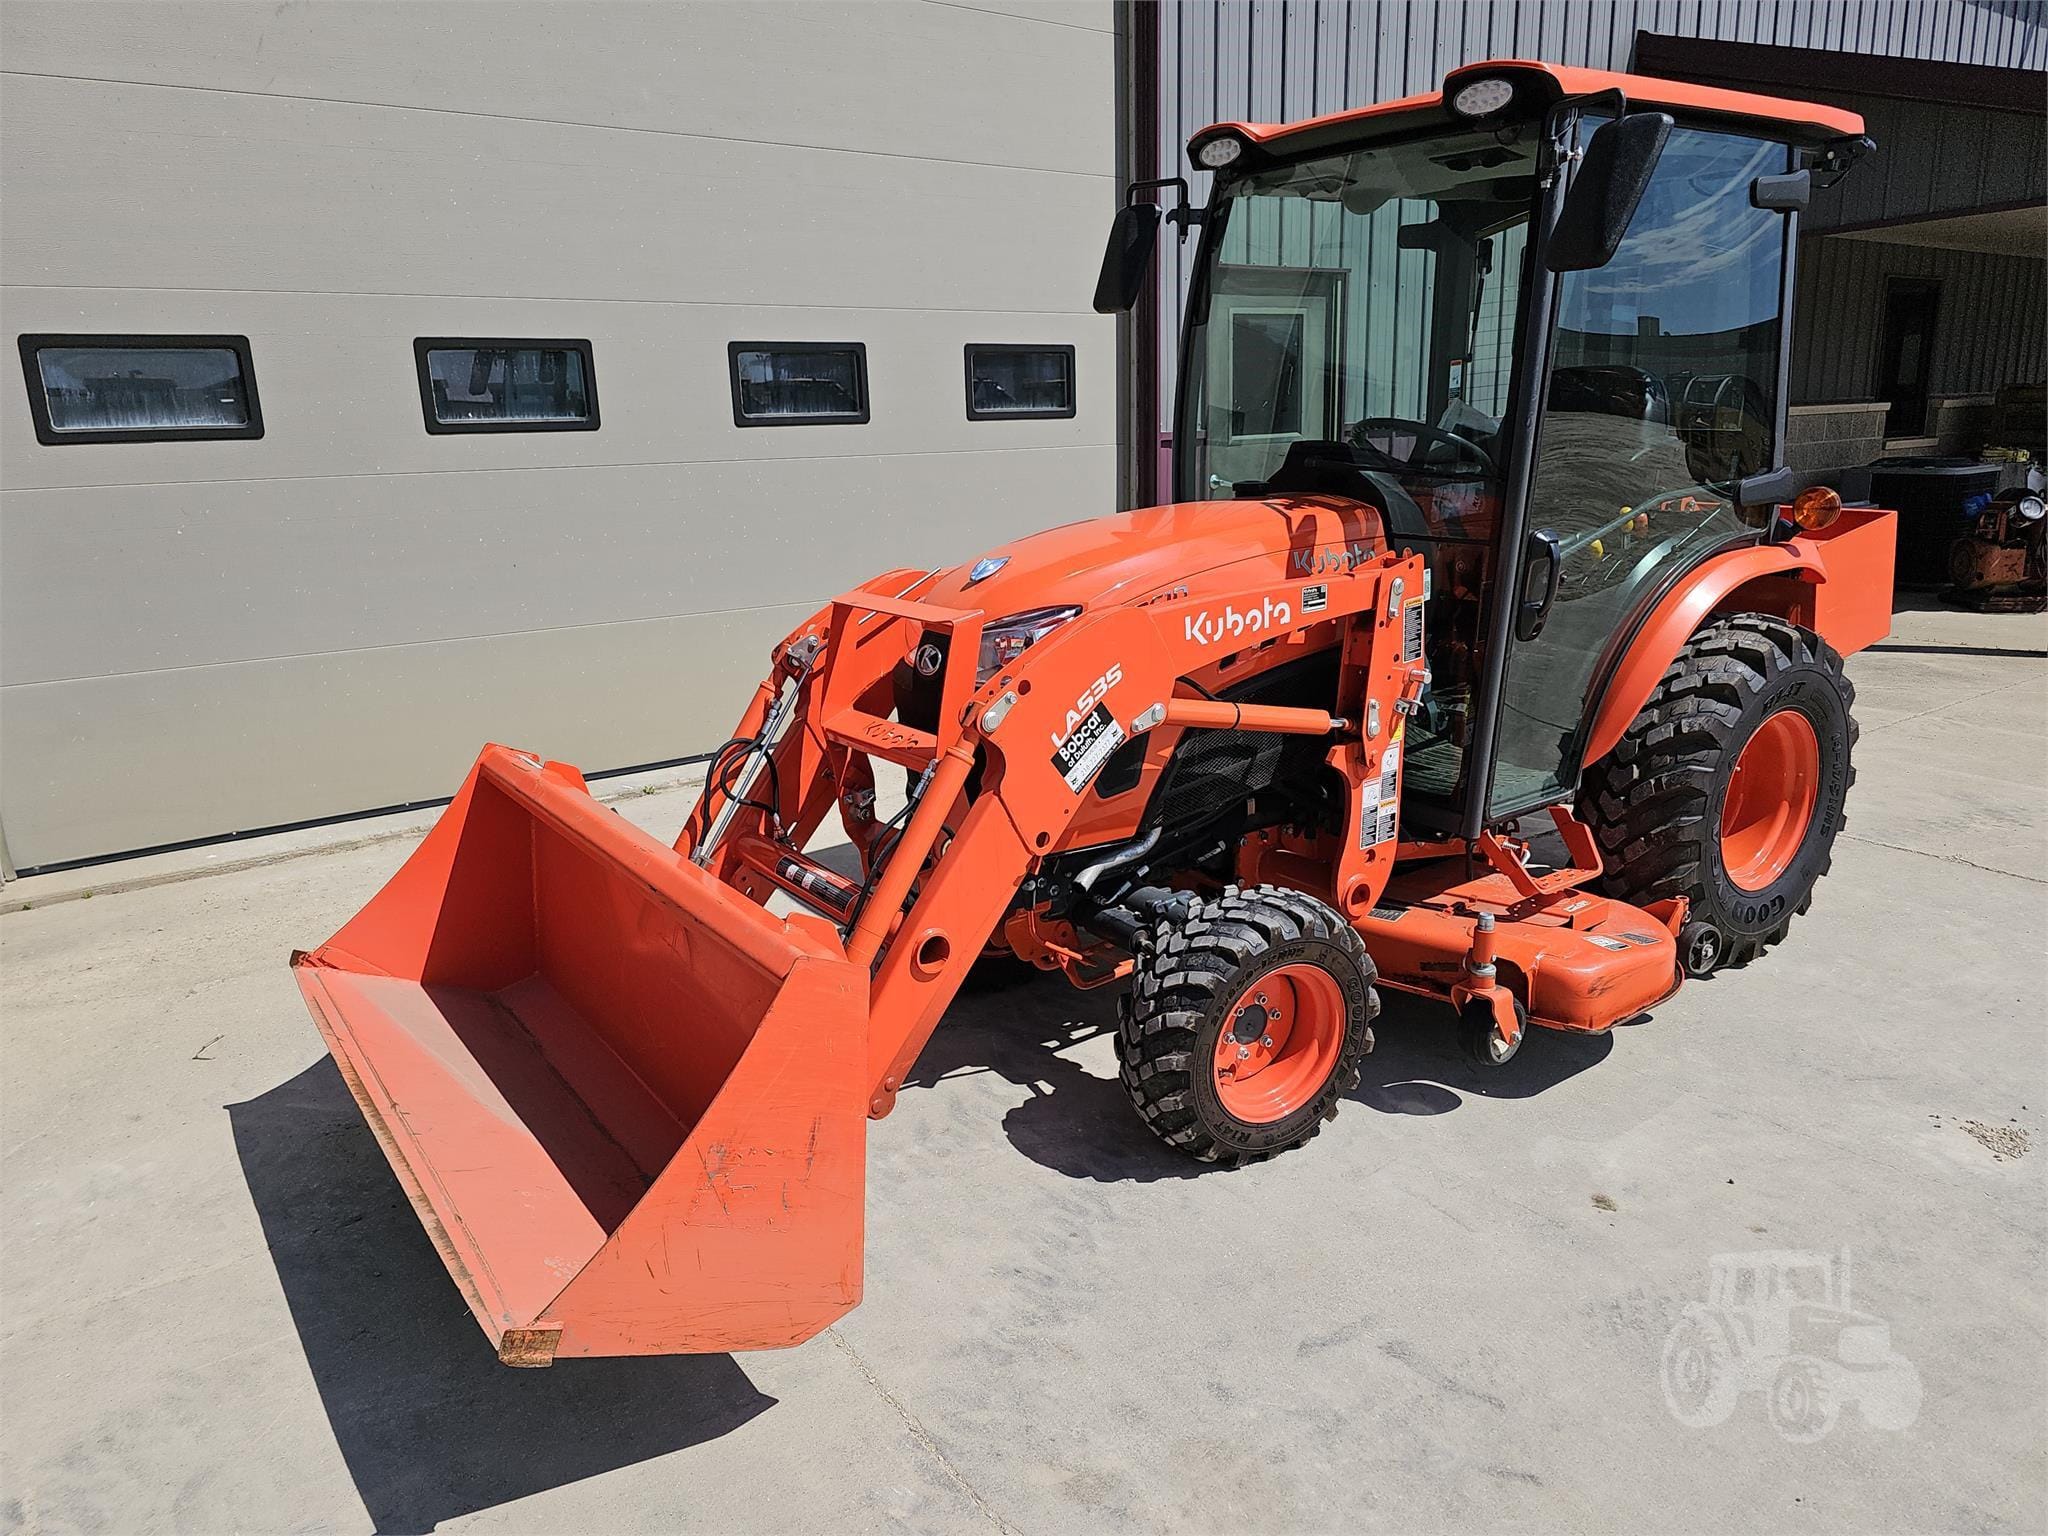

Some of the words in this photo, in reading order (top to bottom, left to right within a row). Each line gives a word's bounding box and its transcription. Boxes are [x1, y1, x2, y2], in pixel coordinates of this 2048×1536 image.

[1185, 596, 1291, 645] Kubota
[1050, 662, 1123, 748] LA535
[1058, 710, 1102, 762] Bobcat
[1067, 757, 1076, 768] of
[1074, 736, 1096, 760] Duluth,
[1093, 723, 1107, 737] Inc.
[1212, 1118, 1252, 1144] R14T
